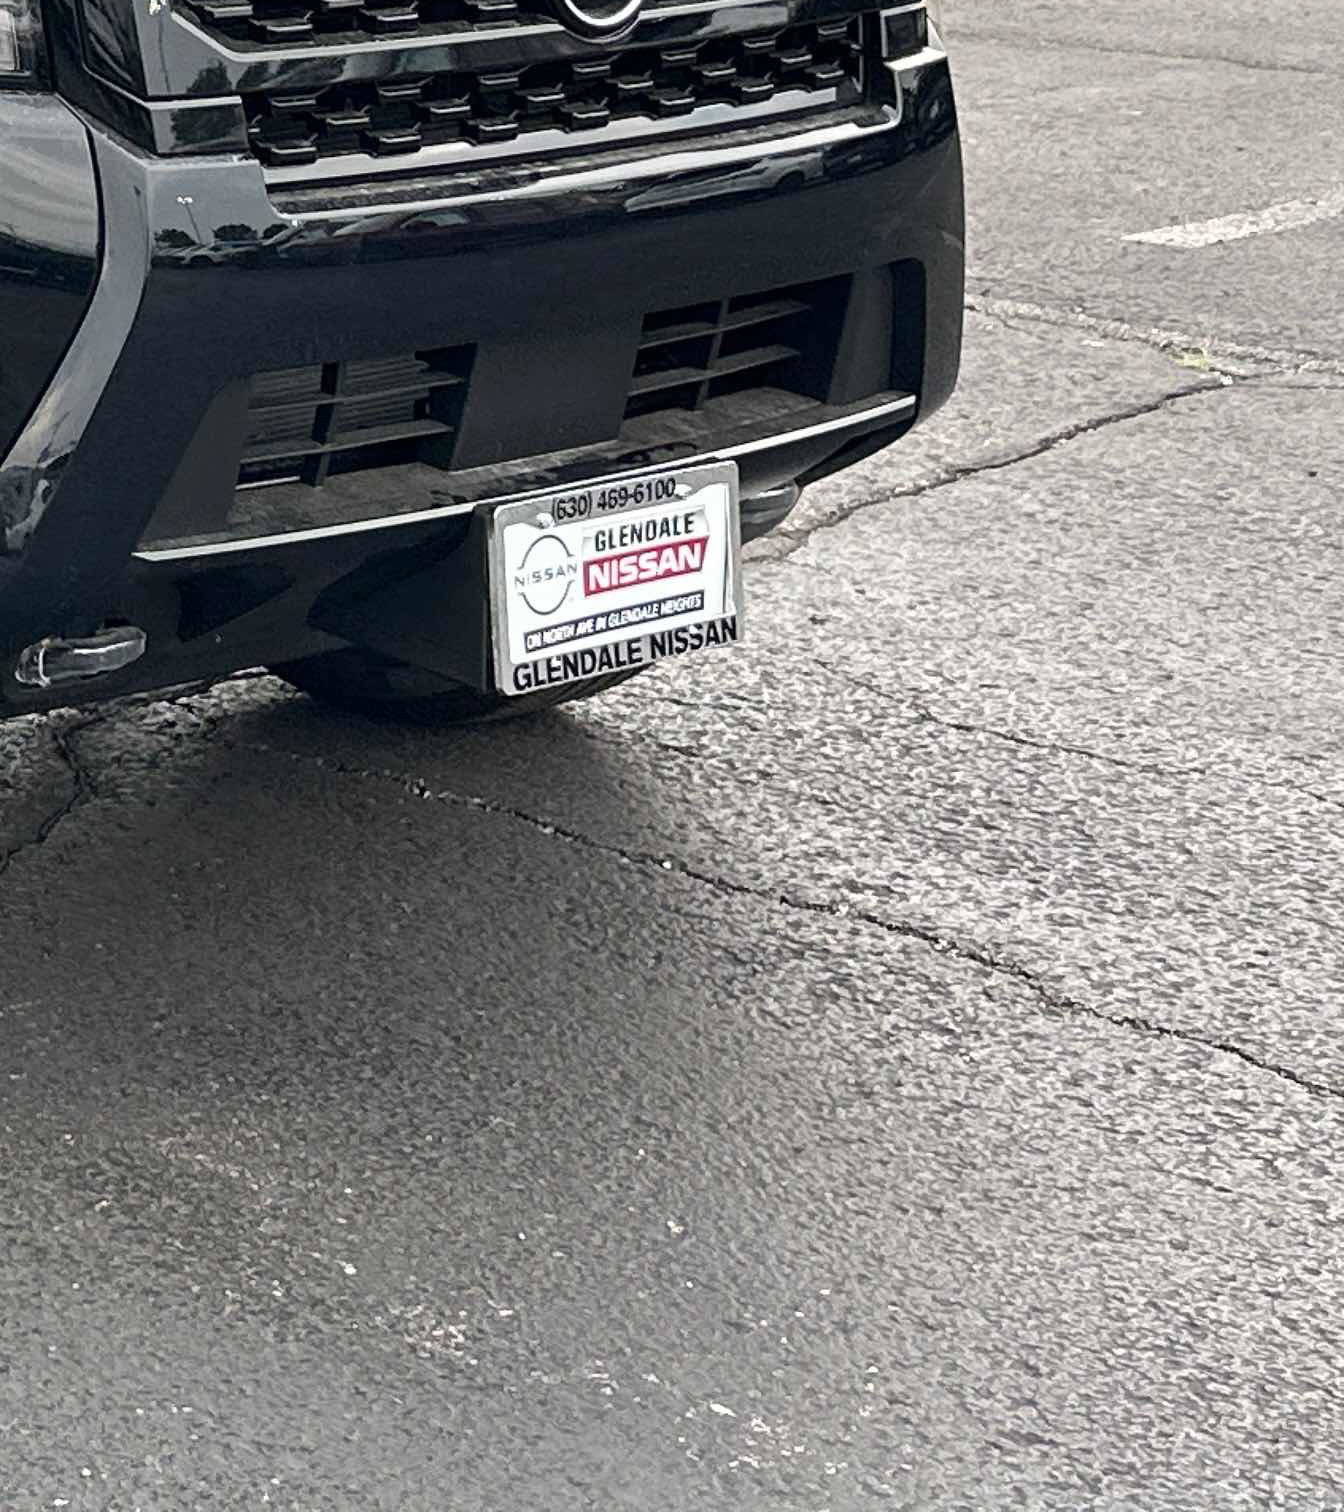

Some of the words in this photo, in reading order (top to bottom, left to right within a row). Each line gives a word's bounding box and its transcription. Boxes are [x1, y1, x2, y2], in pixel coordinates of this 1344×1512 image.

[551, 491, 593, 521] (630)
[597, 477, 677, 512] 469-6100
[595, 512, 696, 552] GLENDALE
[514, 562, 577, 589] NISSAN
[587, 542, 702, 591] NISSAN
[607, 603, 660, 627] GLENDALE
[513, 638, 644, 691] GLENDALE
[651, 616, 738, 661] NISSAN
